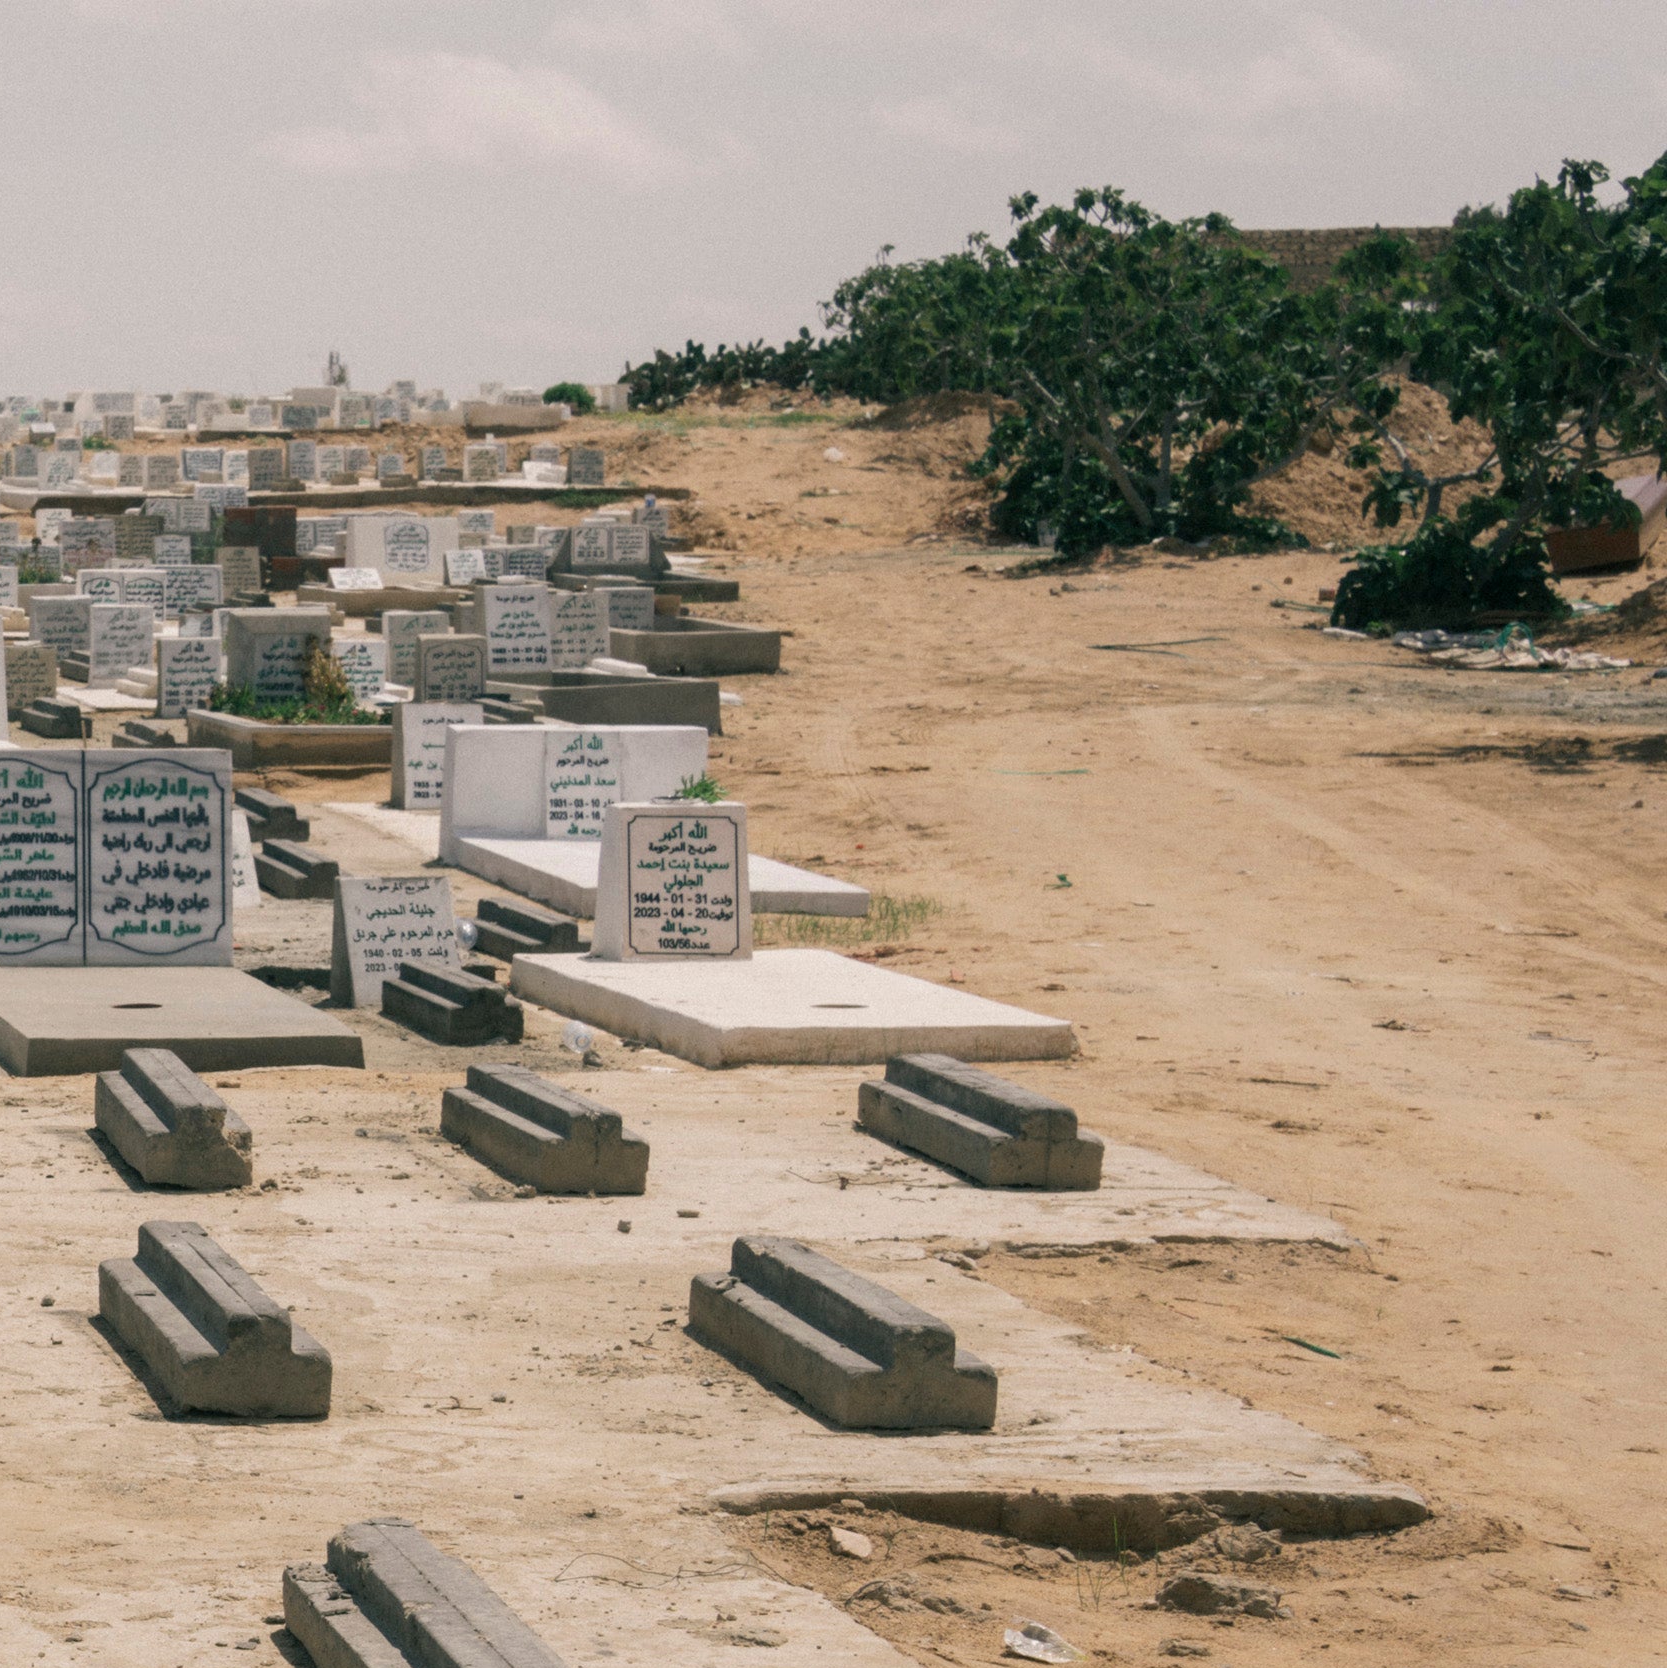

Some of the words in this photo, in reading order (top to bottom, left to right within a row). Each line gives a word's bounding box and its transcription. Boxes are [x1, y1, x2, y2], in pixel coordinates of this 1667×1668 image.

[563, 733, 583, 753] أكبر
[587, 733, 603, 750] الله
[556, 755, 585, 768] المرحوم
[587, 757, 609, 767] ضريح
[16, 766, 44, 789] الله
[594, 778, 616, 787] سعد
[22, 794, 52, 808] ضريح
[567, 823, 578, 835] الله
[658, 821, 683, 841] أكبر
[688, 820, 708, 839] الله
[648, 842, 686, 854] المرحومة
[688, 844, 717, 855] ضريح
[27, 847, 55, 865] ماهر
[669, 859, 691, 872] بنت
[694, 858, 730, 873] سعيدة
[664, 874, 703, 893] الجلولي
[634, 893, 660, 904] 1944
[672, 894, 684, 904] 01
[695, 894, 707, 904] 31
[711, 895, 733, 908] ولدت
[409, 903, 435, 918] جليلة
[634, 907, 661, 918] 2023
[671, 908, 684, 918] 04
[661, 919, 675, 933] الله
[679, 923, 707, 935] رحمها
[400, 926, 433, 942] المرحوم
[365, 963, 386, 972] 2023
